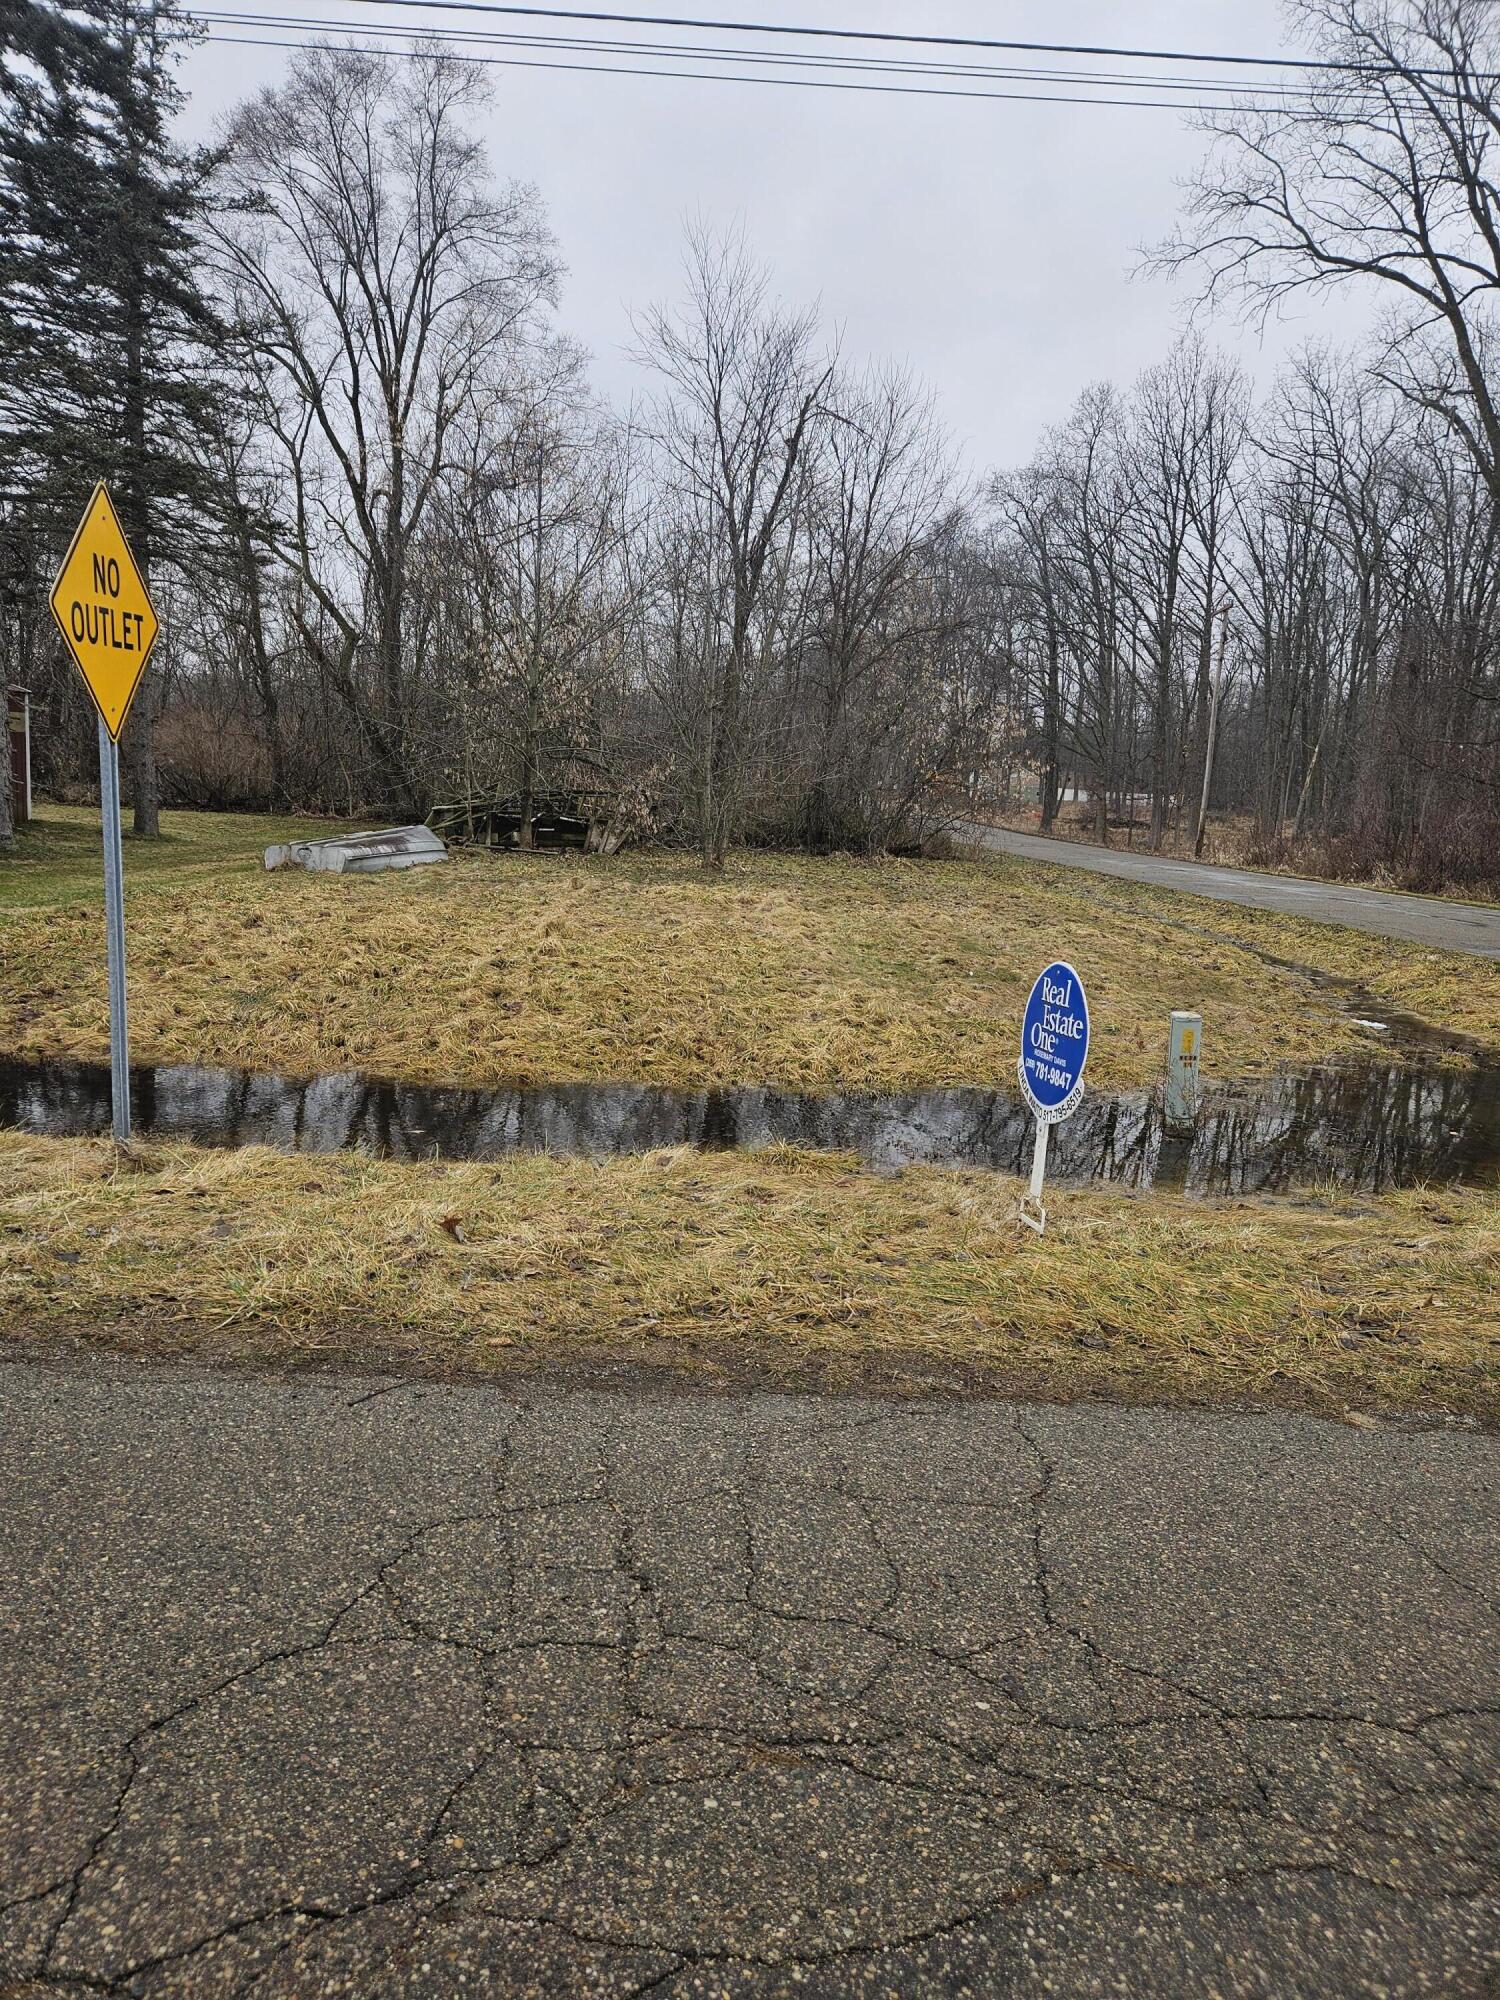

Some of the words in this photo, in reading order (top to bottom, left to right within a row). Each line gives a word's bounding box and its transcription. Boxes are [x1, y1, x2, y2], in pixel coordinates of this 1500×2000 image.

[92, 552, 120, 598] NO
[71, 601, 144, 652] OUTLET
[1041, 976, 1072, 1008] Real
[1031, 1022, 1056, 1053] One
[1042, 1004, 1084, 1039] Estate
[1035, 1061, 1072, 1090] 781-9847
[1053, 1056, 1067, 1067] DAVIS
[1042, 1087, 1082, 1121] 517-795-6519
